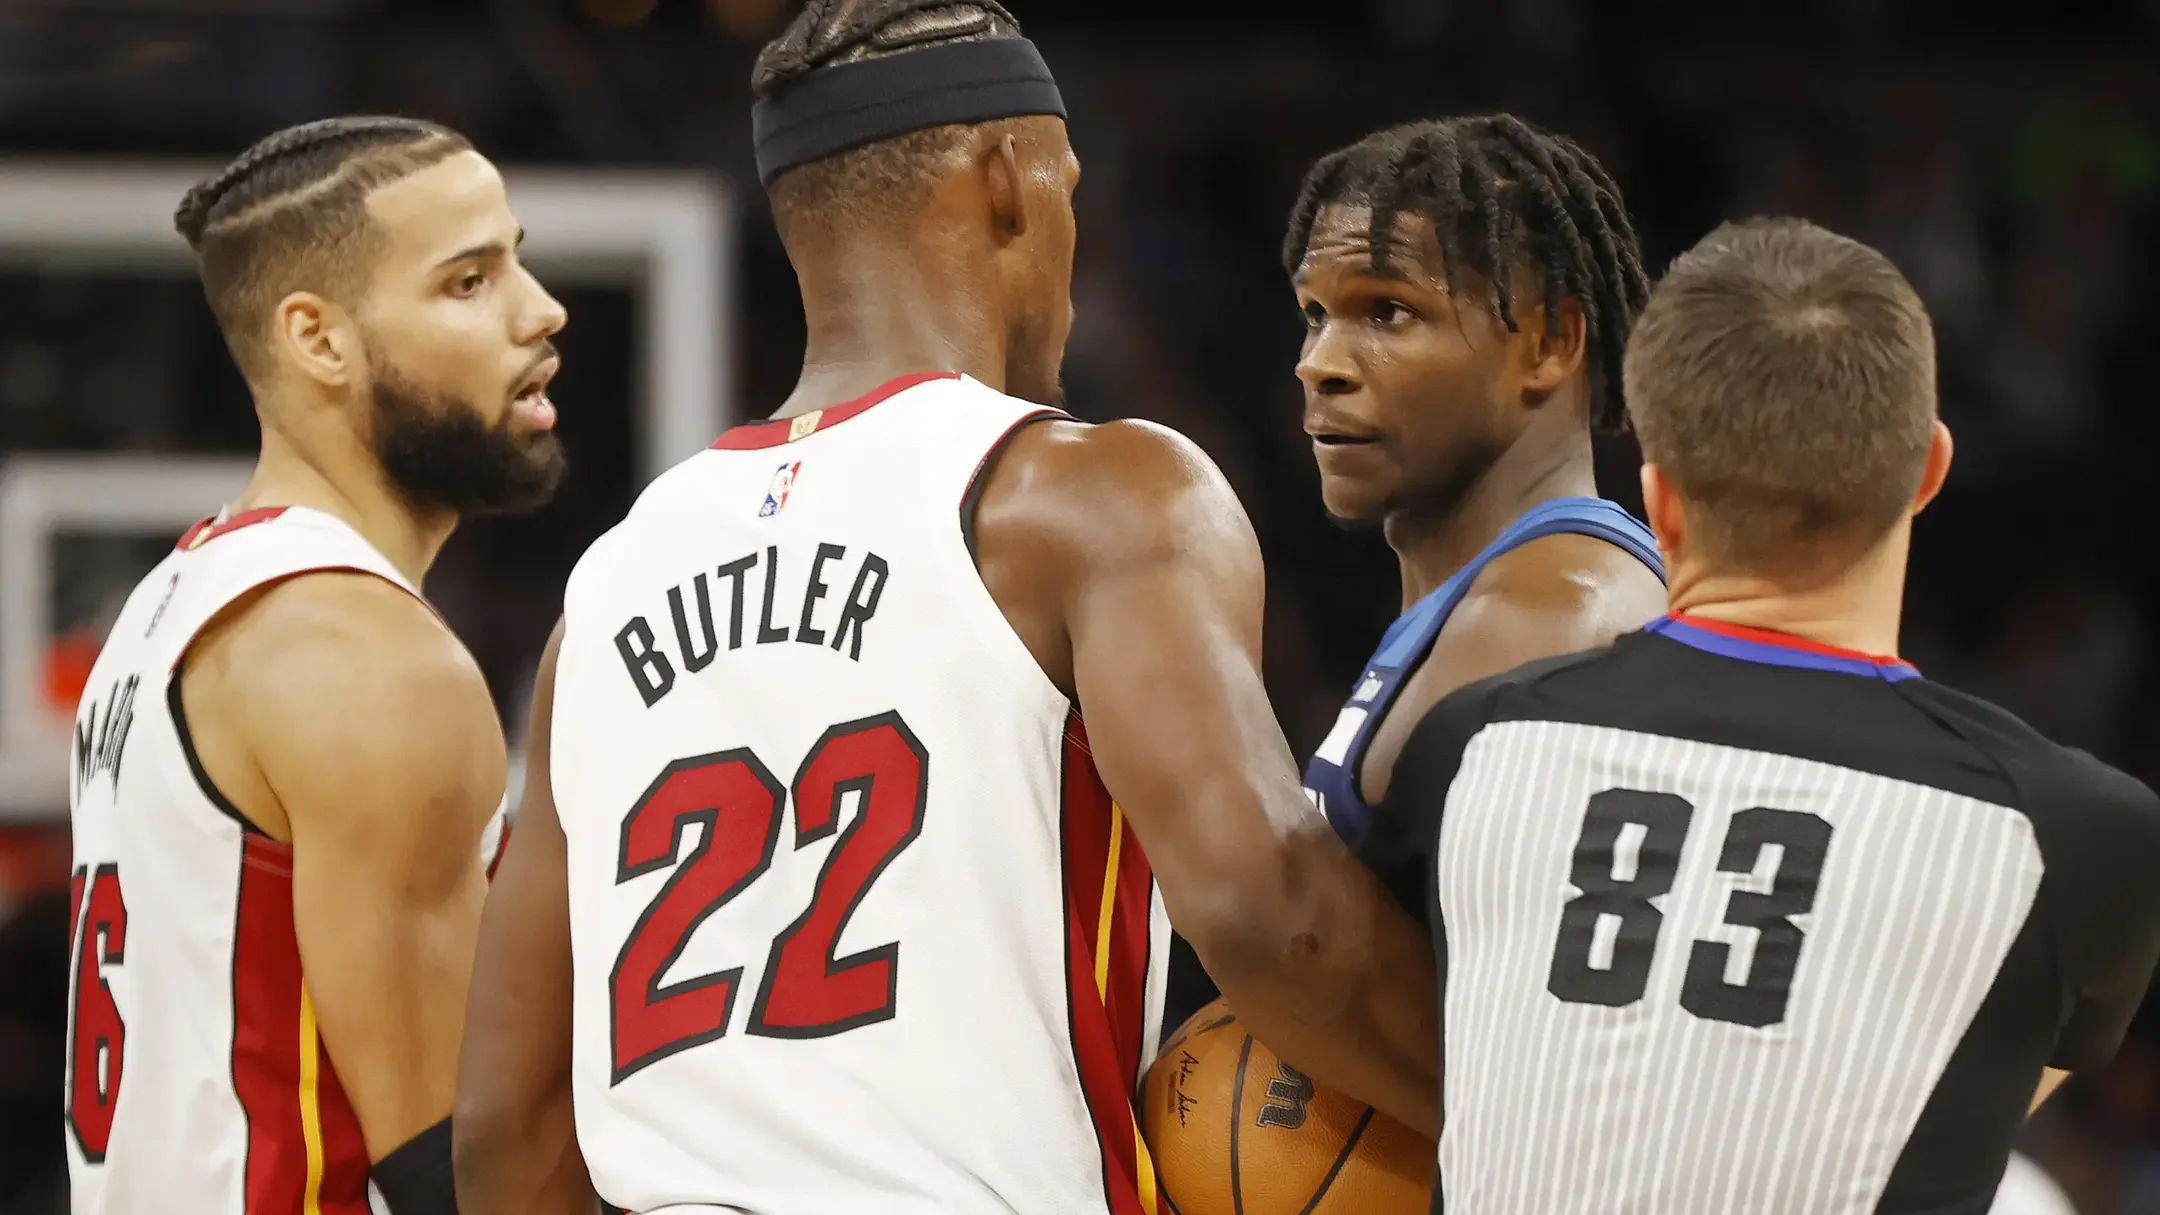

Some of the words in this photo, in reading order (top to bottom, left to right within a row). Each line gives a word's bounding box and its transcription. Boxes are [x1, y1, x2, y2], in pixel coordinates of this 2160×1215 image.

[613, 541, 890, 709] BUTLER
[608, 709, 930, 1089] 22
[1546, 787, 1835, 1029] 83
